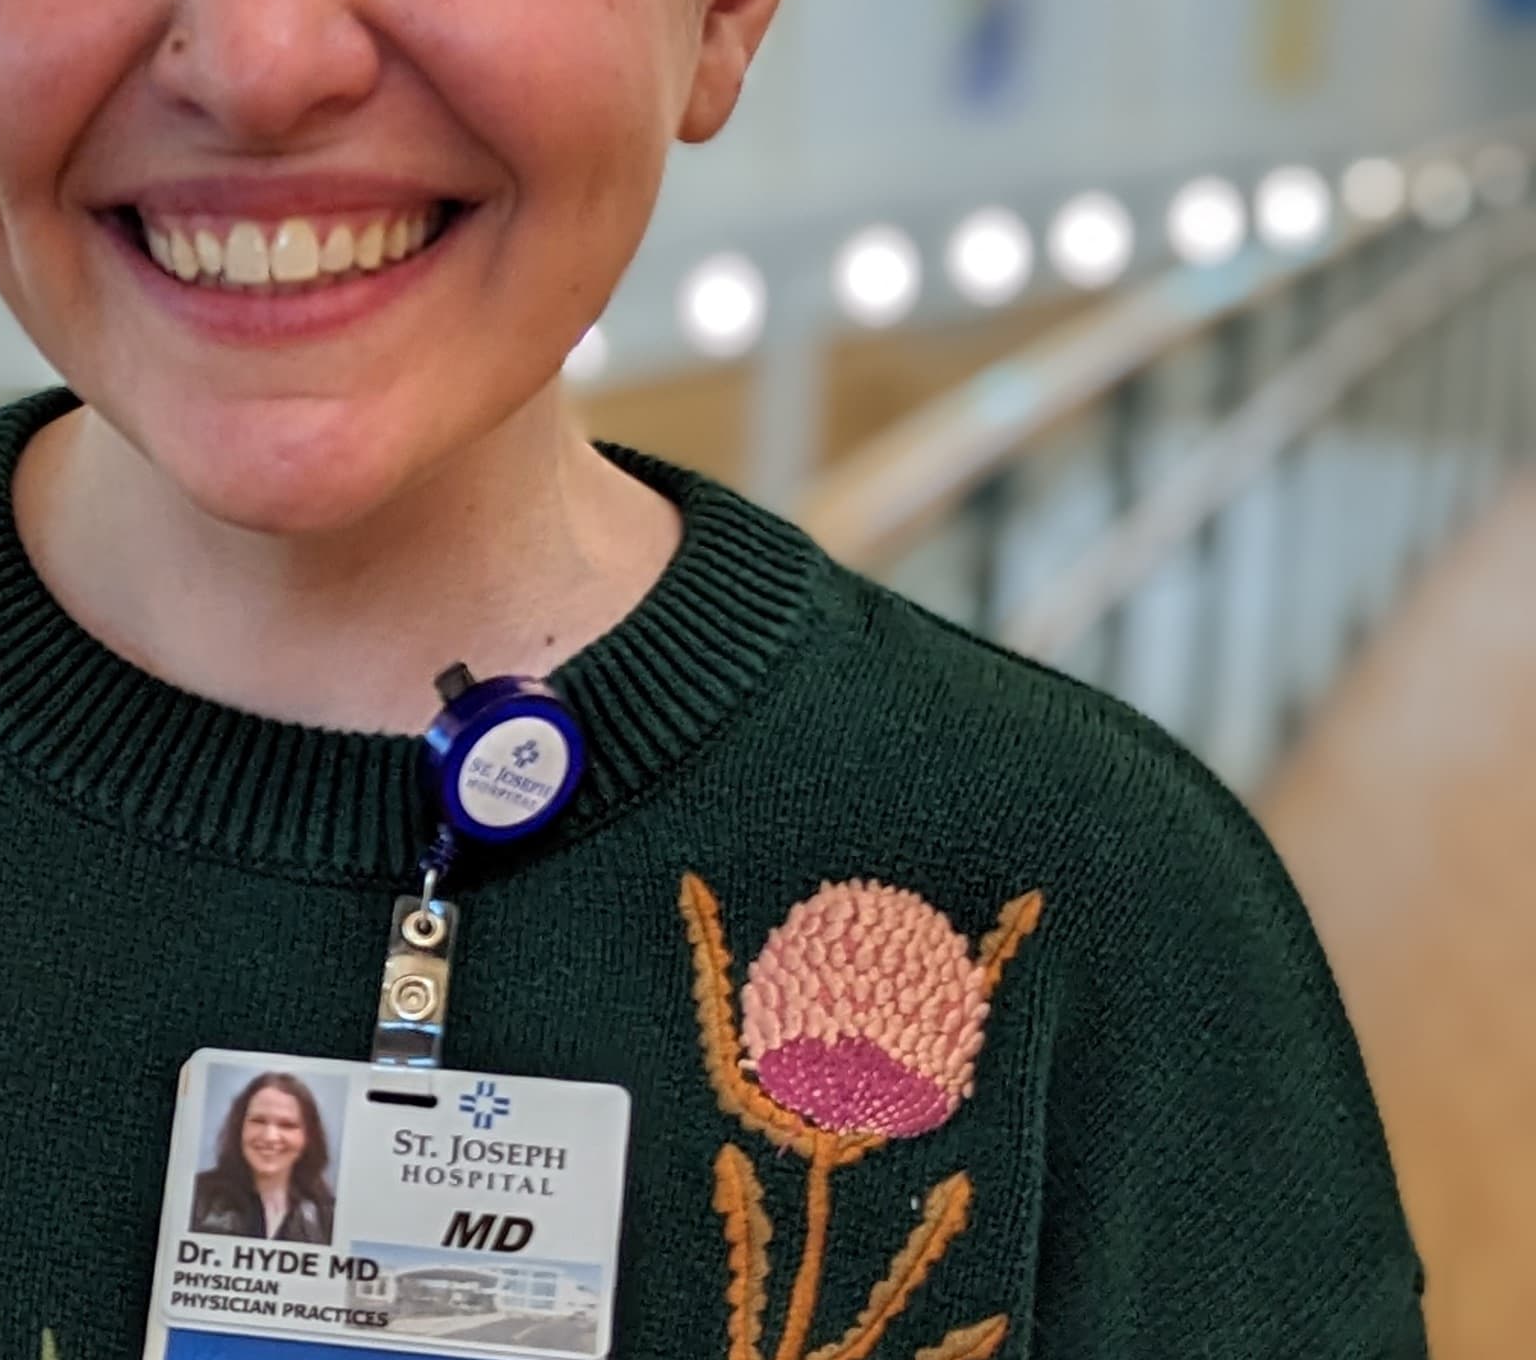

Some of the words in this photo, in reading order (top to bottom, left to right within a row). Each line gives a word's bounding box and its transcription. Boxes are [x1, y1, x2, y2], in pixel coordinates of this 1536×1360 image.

[393, 1129, 437, 1159] ST.
[447, 1135, 566, 1170] JOSEPH
[401, 1164, 553, 1196] HOSPITAL
[441, 1210, 534, 1253] MD
[177, 1241, 221, 1267] Dr.
[232, 1246, 318, 1277] HYDE
[329, 1256, 378, 1281] MD
[173, 1271, 279, 1295] PHYSICIAN
[170, 1291, 276, 1316] PHYSICIAN
[281, 1303, 389, 1327] PRACTICES
